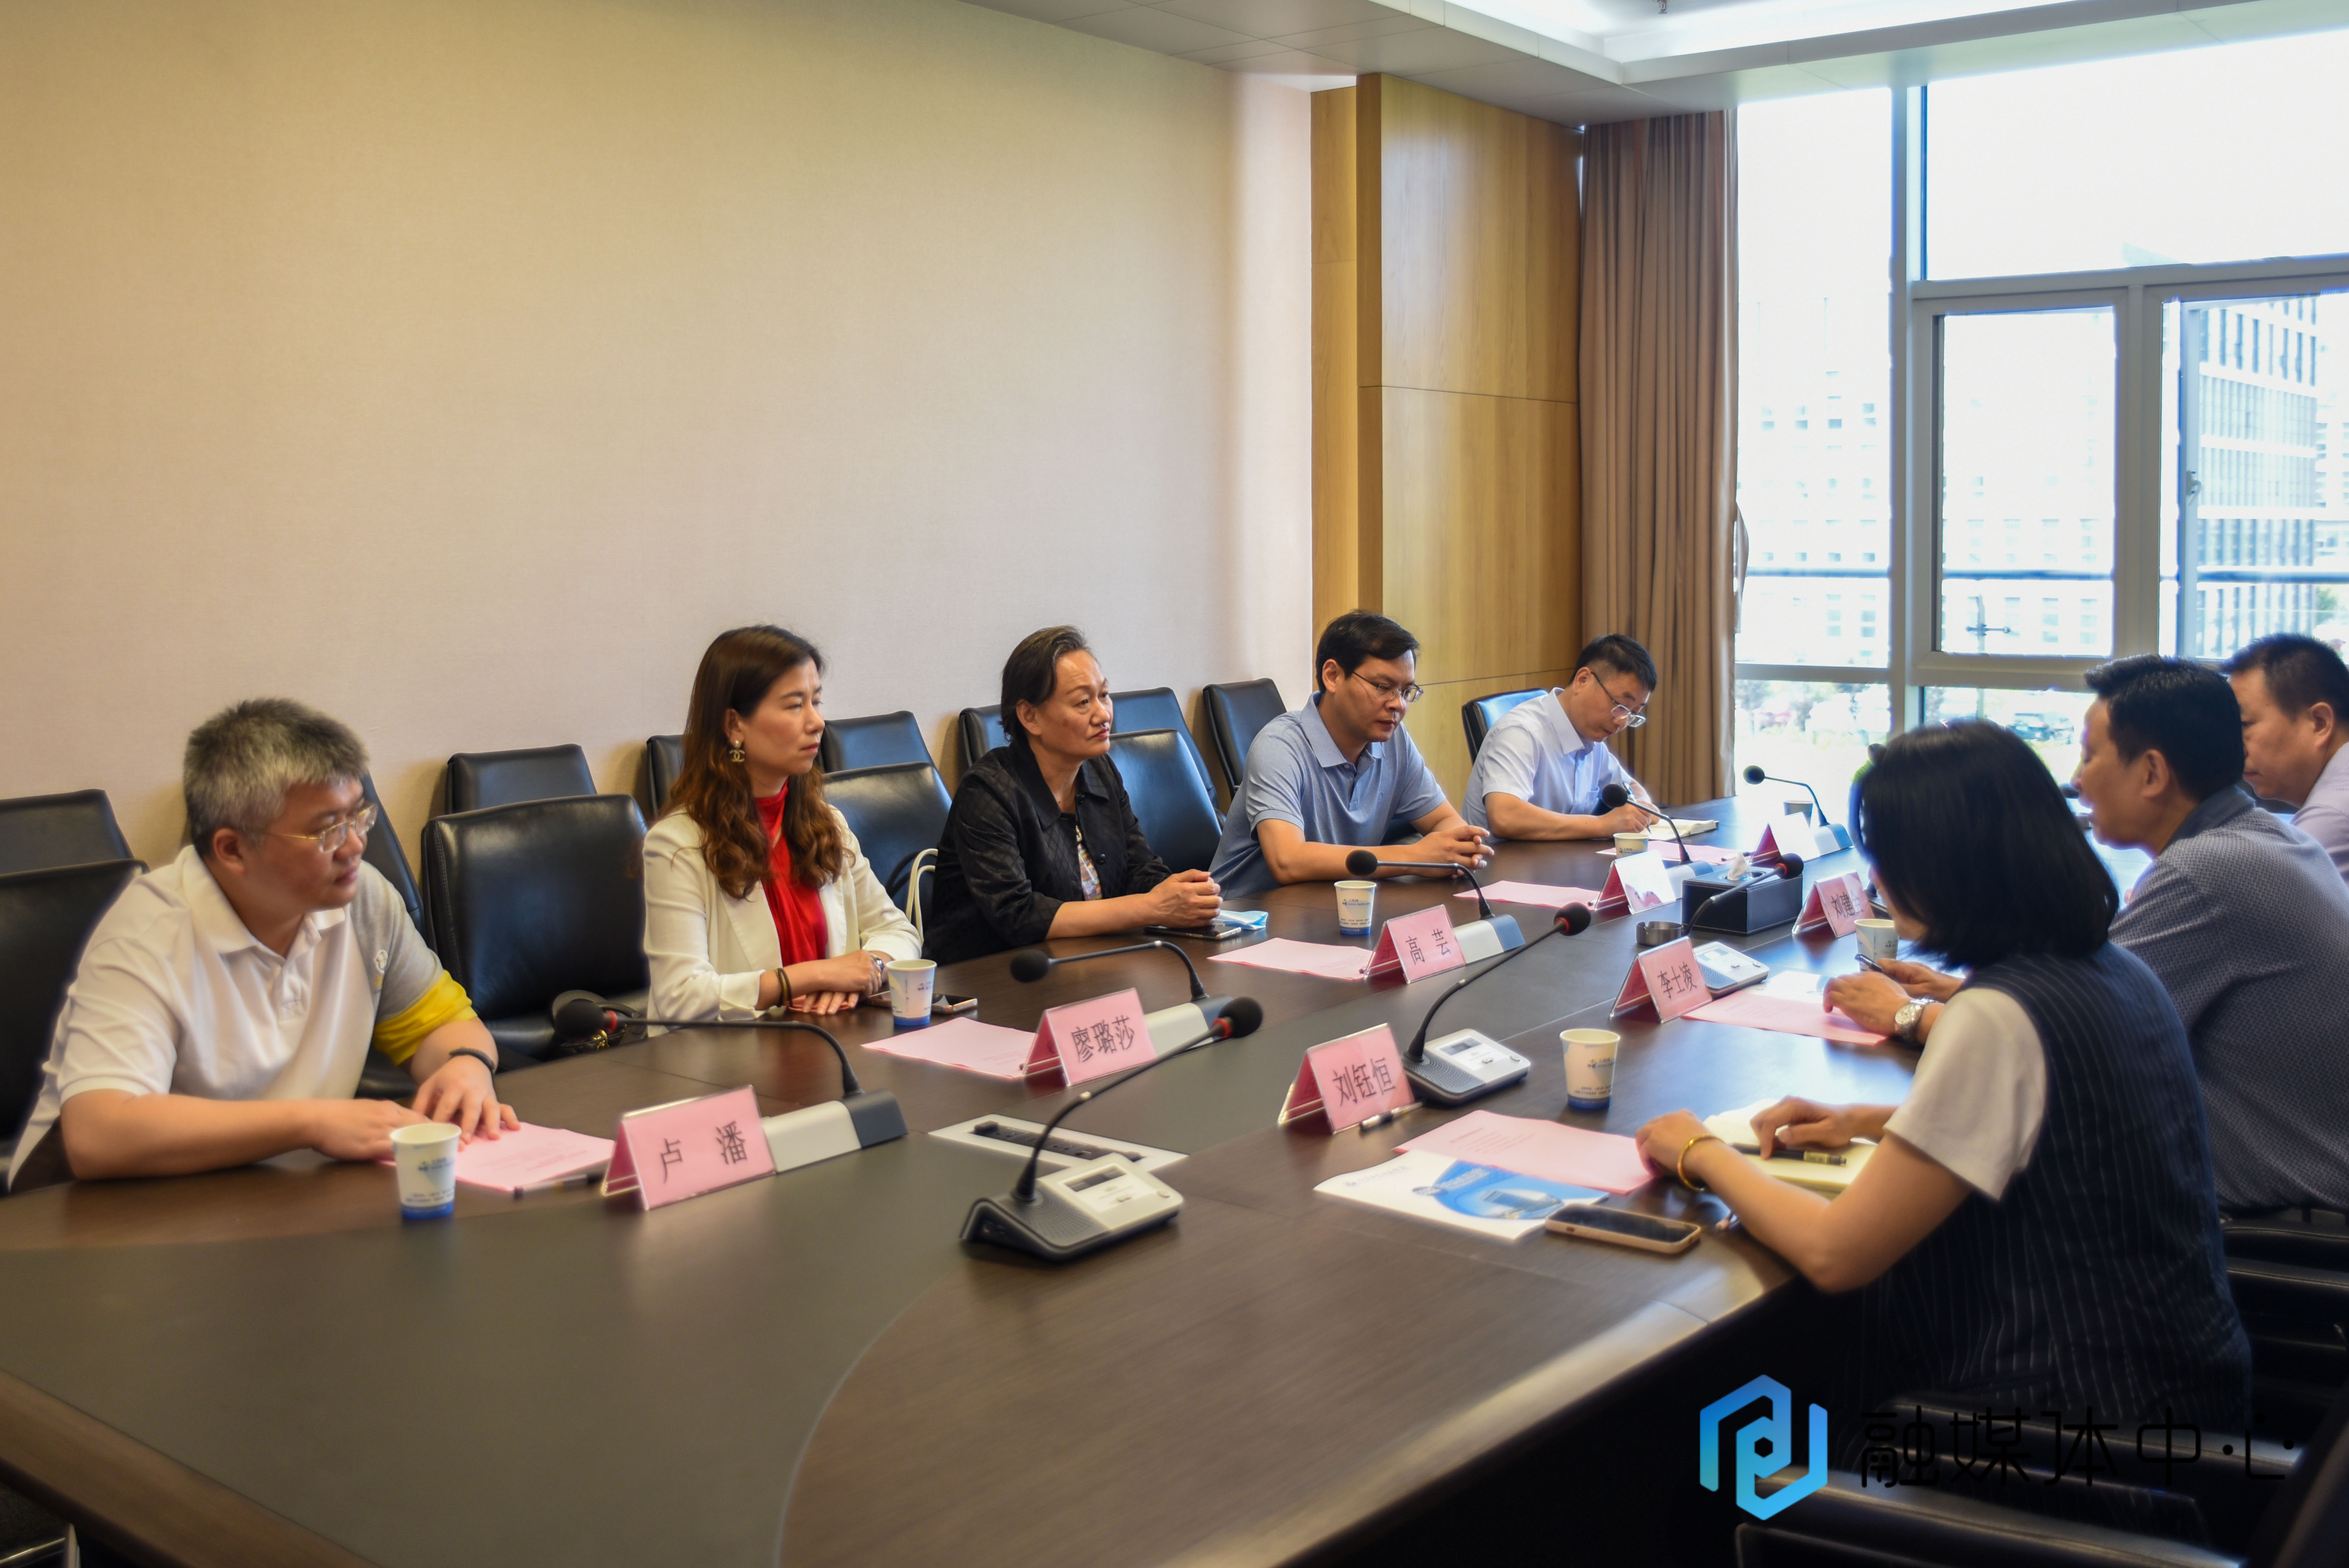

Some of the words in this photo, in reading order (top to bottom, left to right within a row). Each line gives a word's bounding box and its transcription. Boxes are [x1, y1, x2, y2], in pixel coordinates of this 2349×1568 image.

[1405, 928, 1451, 966] 高芸
[1657, 962, 1697, 999] 李士凌
[1071, 1015, 1135, 1063] 廖璐莎
[1332, 1058, 1396, 1107] 刘钰恒
[660, 1120, 747, 1184] 卢潘
